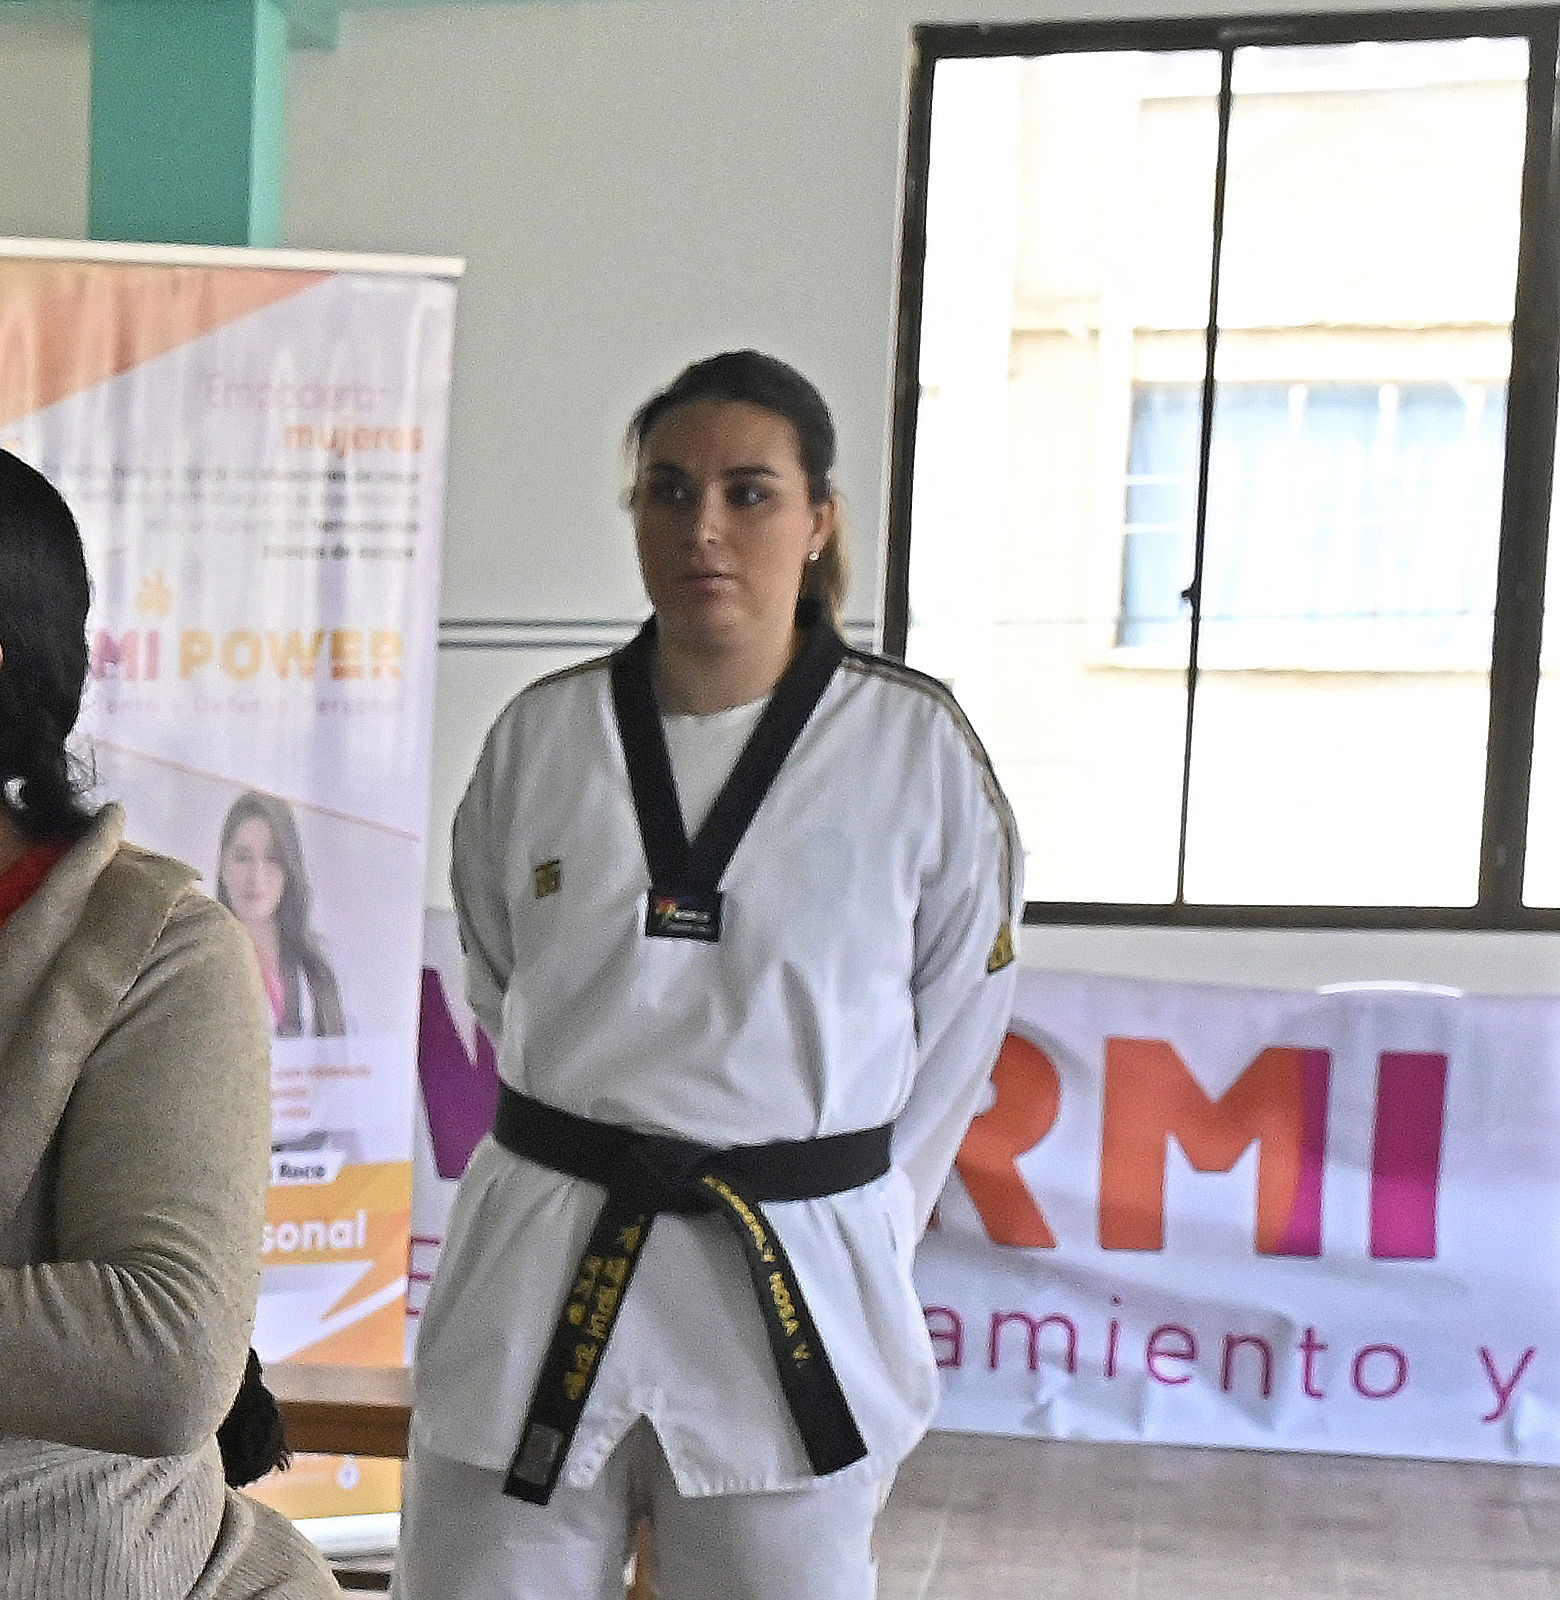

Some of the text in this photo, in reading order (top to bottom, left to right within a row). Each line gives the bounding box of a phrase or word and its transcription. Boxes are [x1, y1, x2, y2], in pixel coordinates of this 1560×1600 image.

[178, 629, 405, 682] POWER
[261, 1208, 368, 1254] sonal
[923, 1293, 1537, 1422] amiento y
